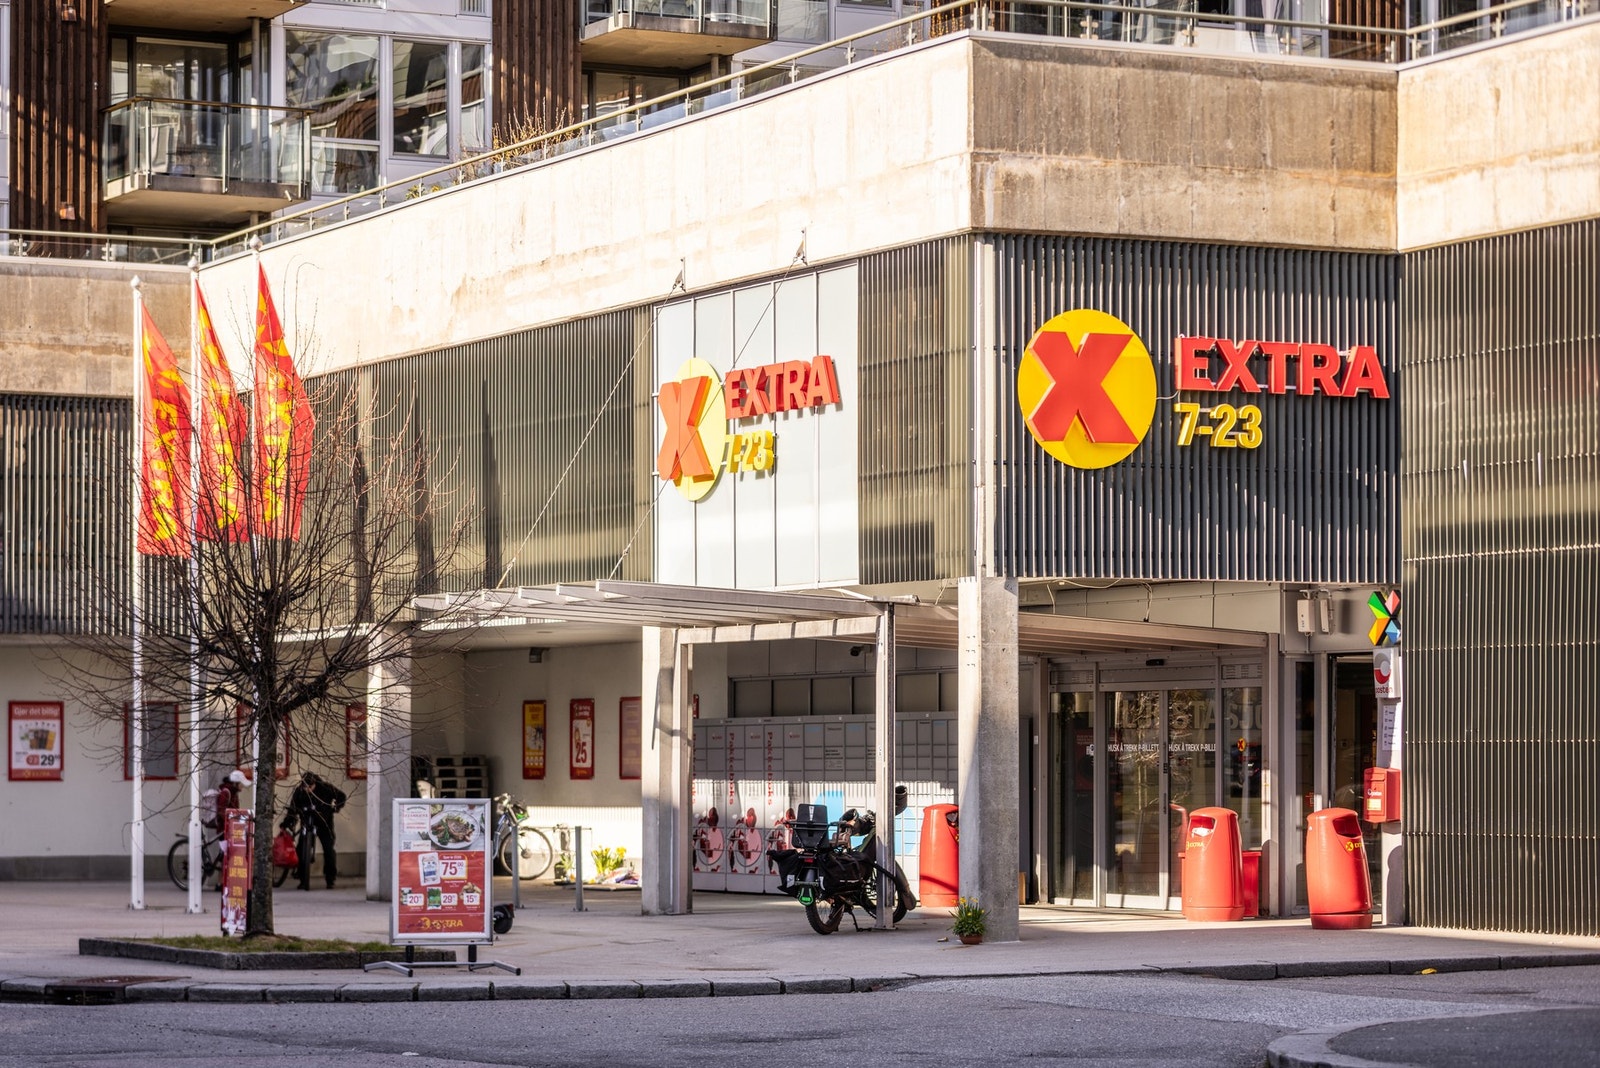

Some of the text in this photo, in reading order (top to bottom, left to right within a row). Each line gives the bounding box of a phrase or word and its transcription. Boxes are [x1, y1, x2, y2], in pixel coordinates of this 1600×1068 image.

[1174, 336, 1390, 398] EXTRA
[725, 355, 840, 420] EXTRA
[1174, 402, 1263, 449] 7-23
[725, 430, 775, 474] 7-23
[575, 742, 588, 764] 25
[1107, 744, 1120, 752] HUSK
[1124, 744, 1138, 752] TREKK
[1169, 744, 1181, 752] HUSK
[1185, 744, 1200, 752] TREKK
[41, 754, 55, 766] 29
[441, 862, 458, 876] 75
[409, 896, 419, 904] 20
[466, 895, 475, 903] 15
